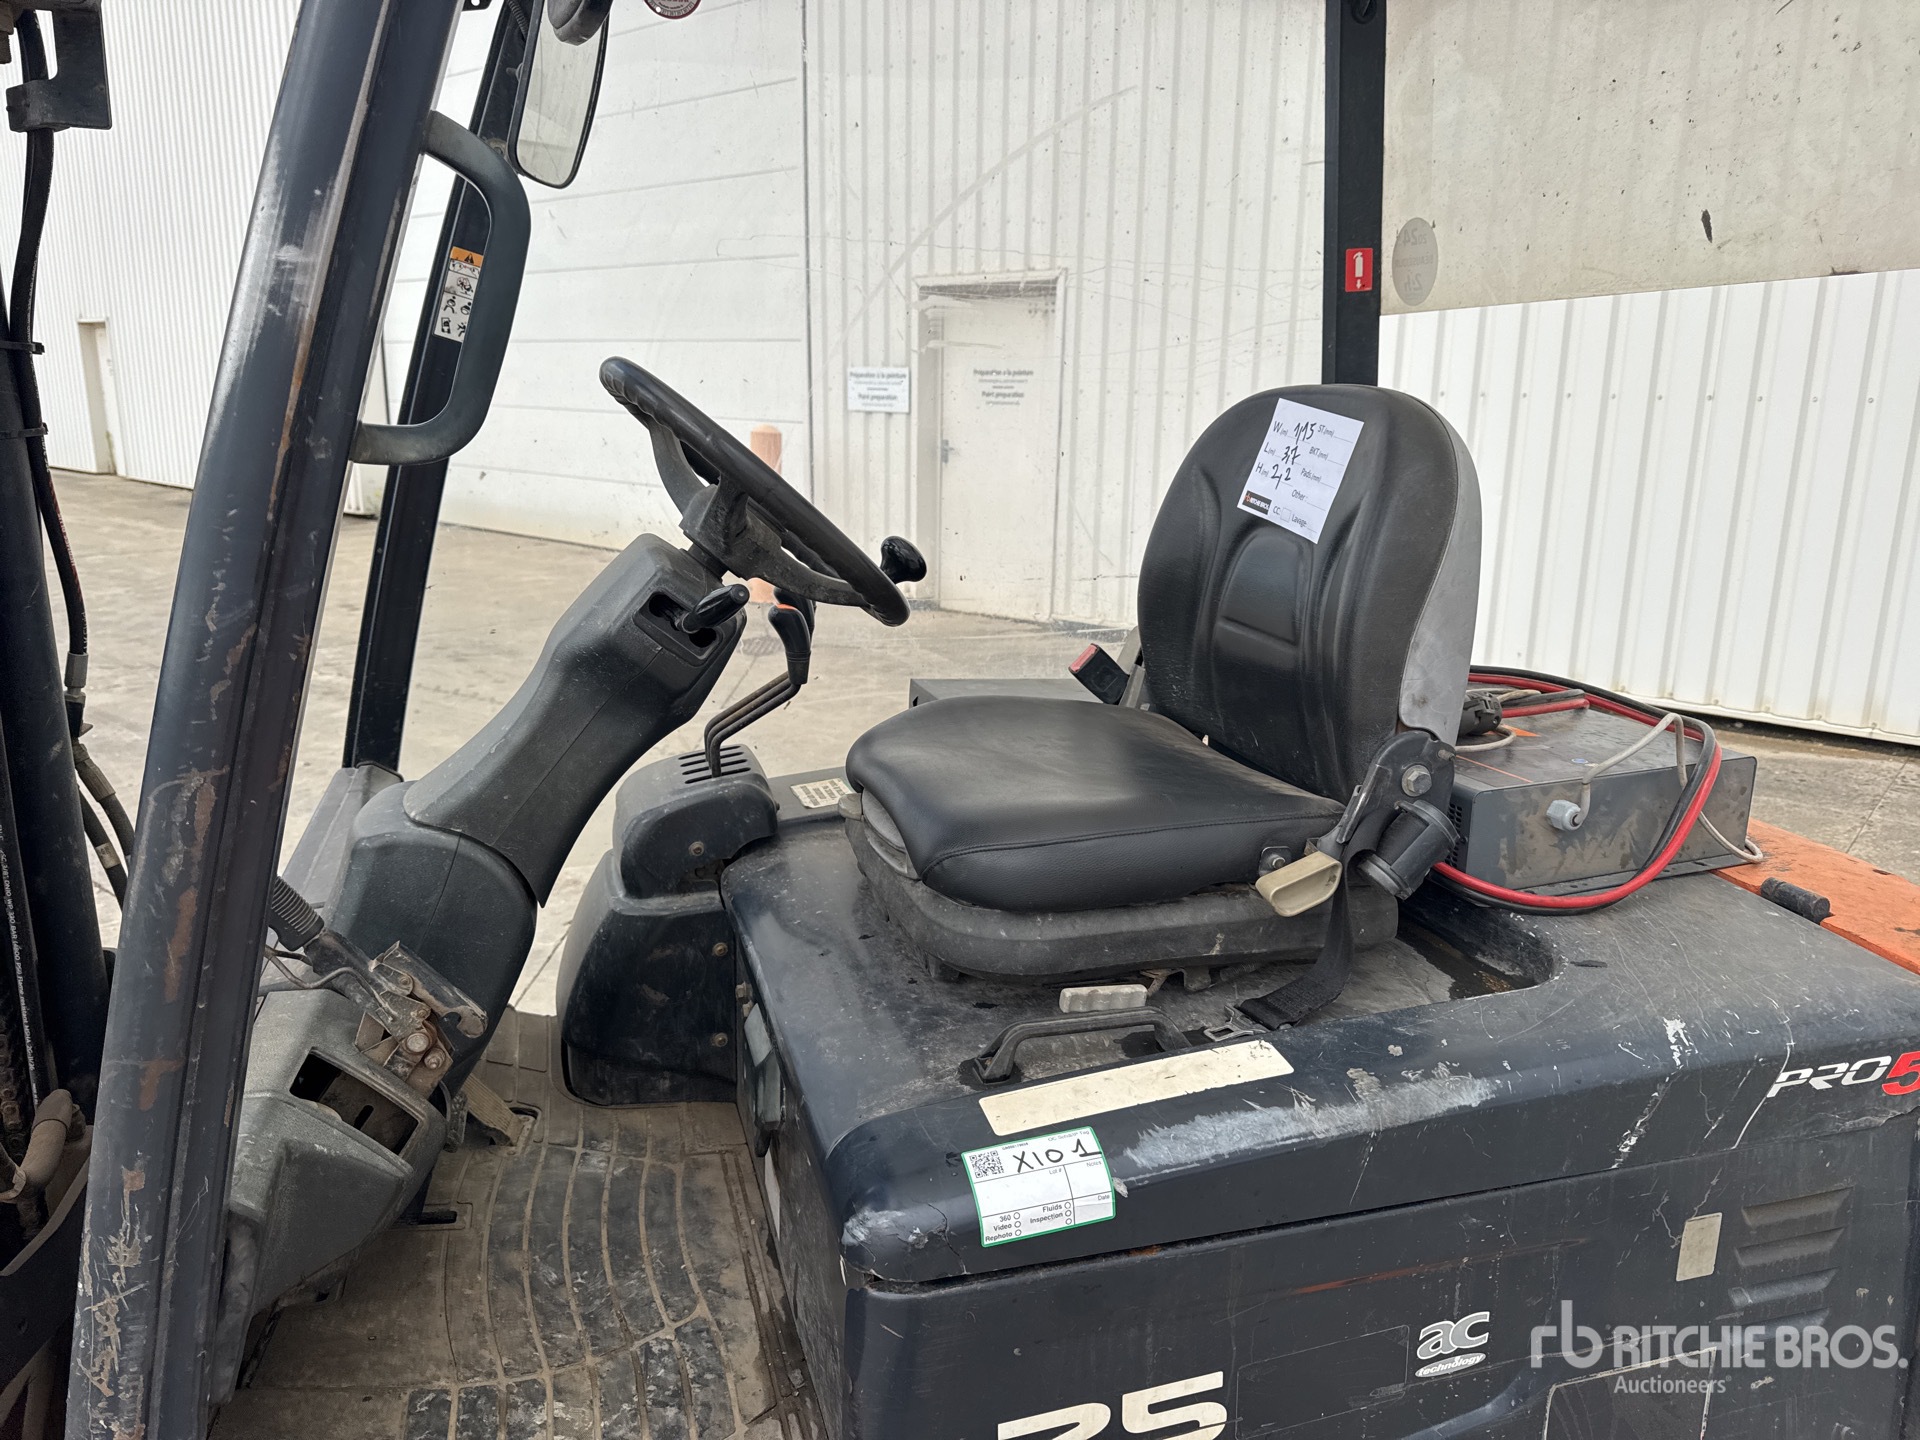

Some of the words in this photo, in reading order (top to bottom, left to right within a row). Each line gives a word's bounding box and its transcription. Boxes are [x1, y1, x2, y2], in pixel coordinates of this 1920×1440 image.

[1042, 1204, 1063, 1213] Fluids
[999, 1214, 1012, 1223] 360
[1029, 1212, 1063, 1224] Inspection
[993, 1223, 1012, 1232] Video
[985, 1232, 1013, 1243] Rephoto
[1417, 1311, 1490, 1360] ac
[1419, 1354, 1484, 1376] technology
